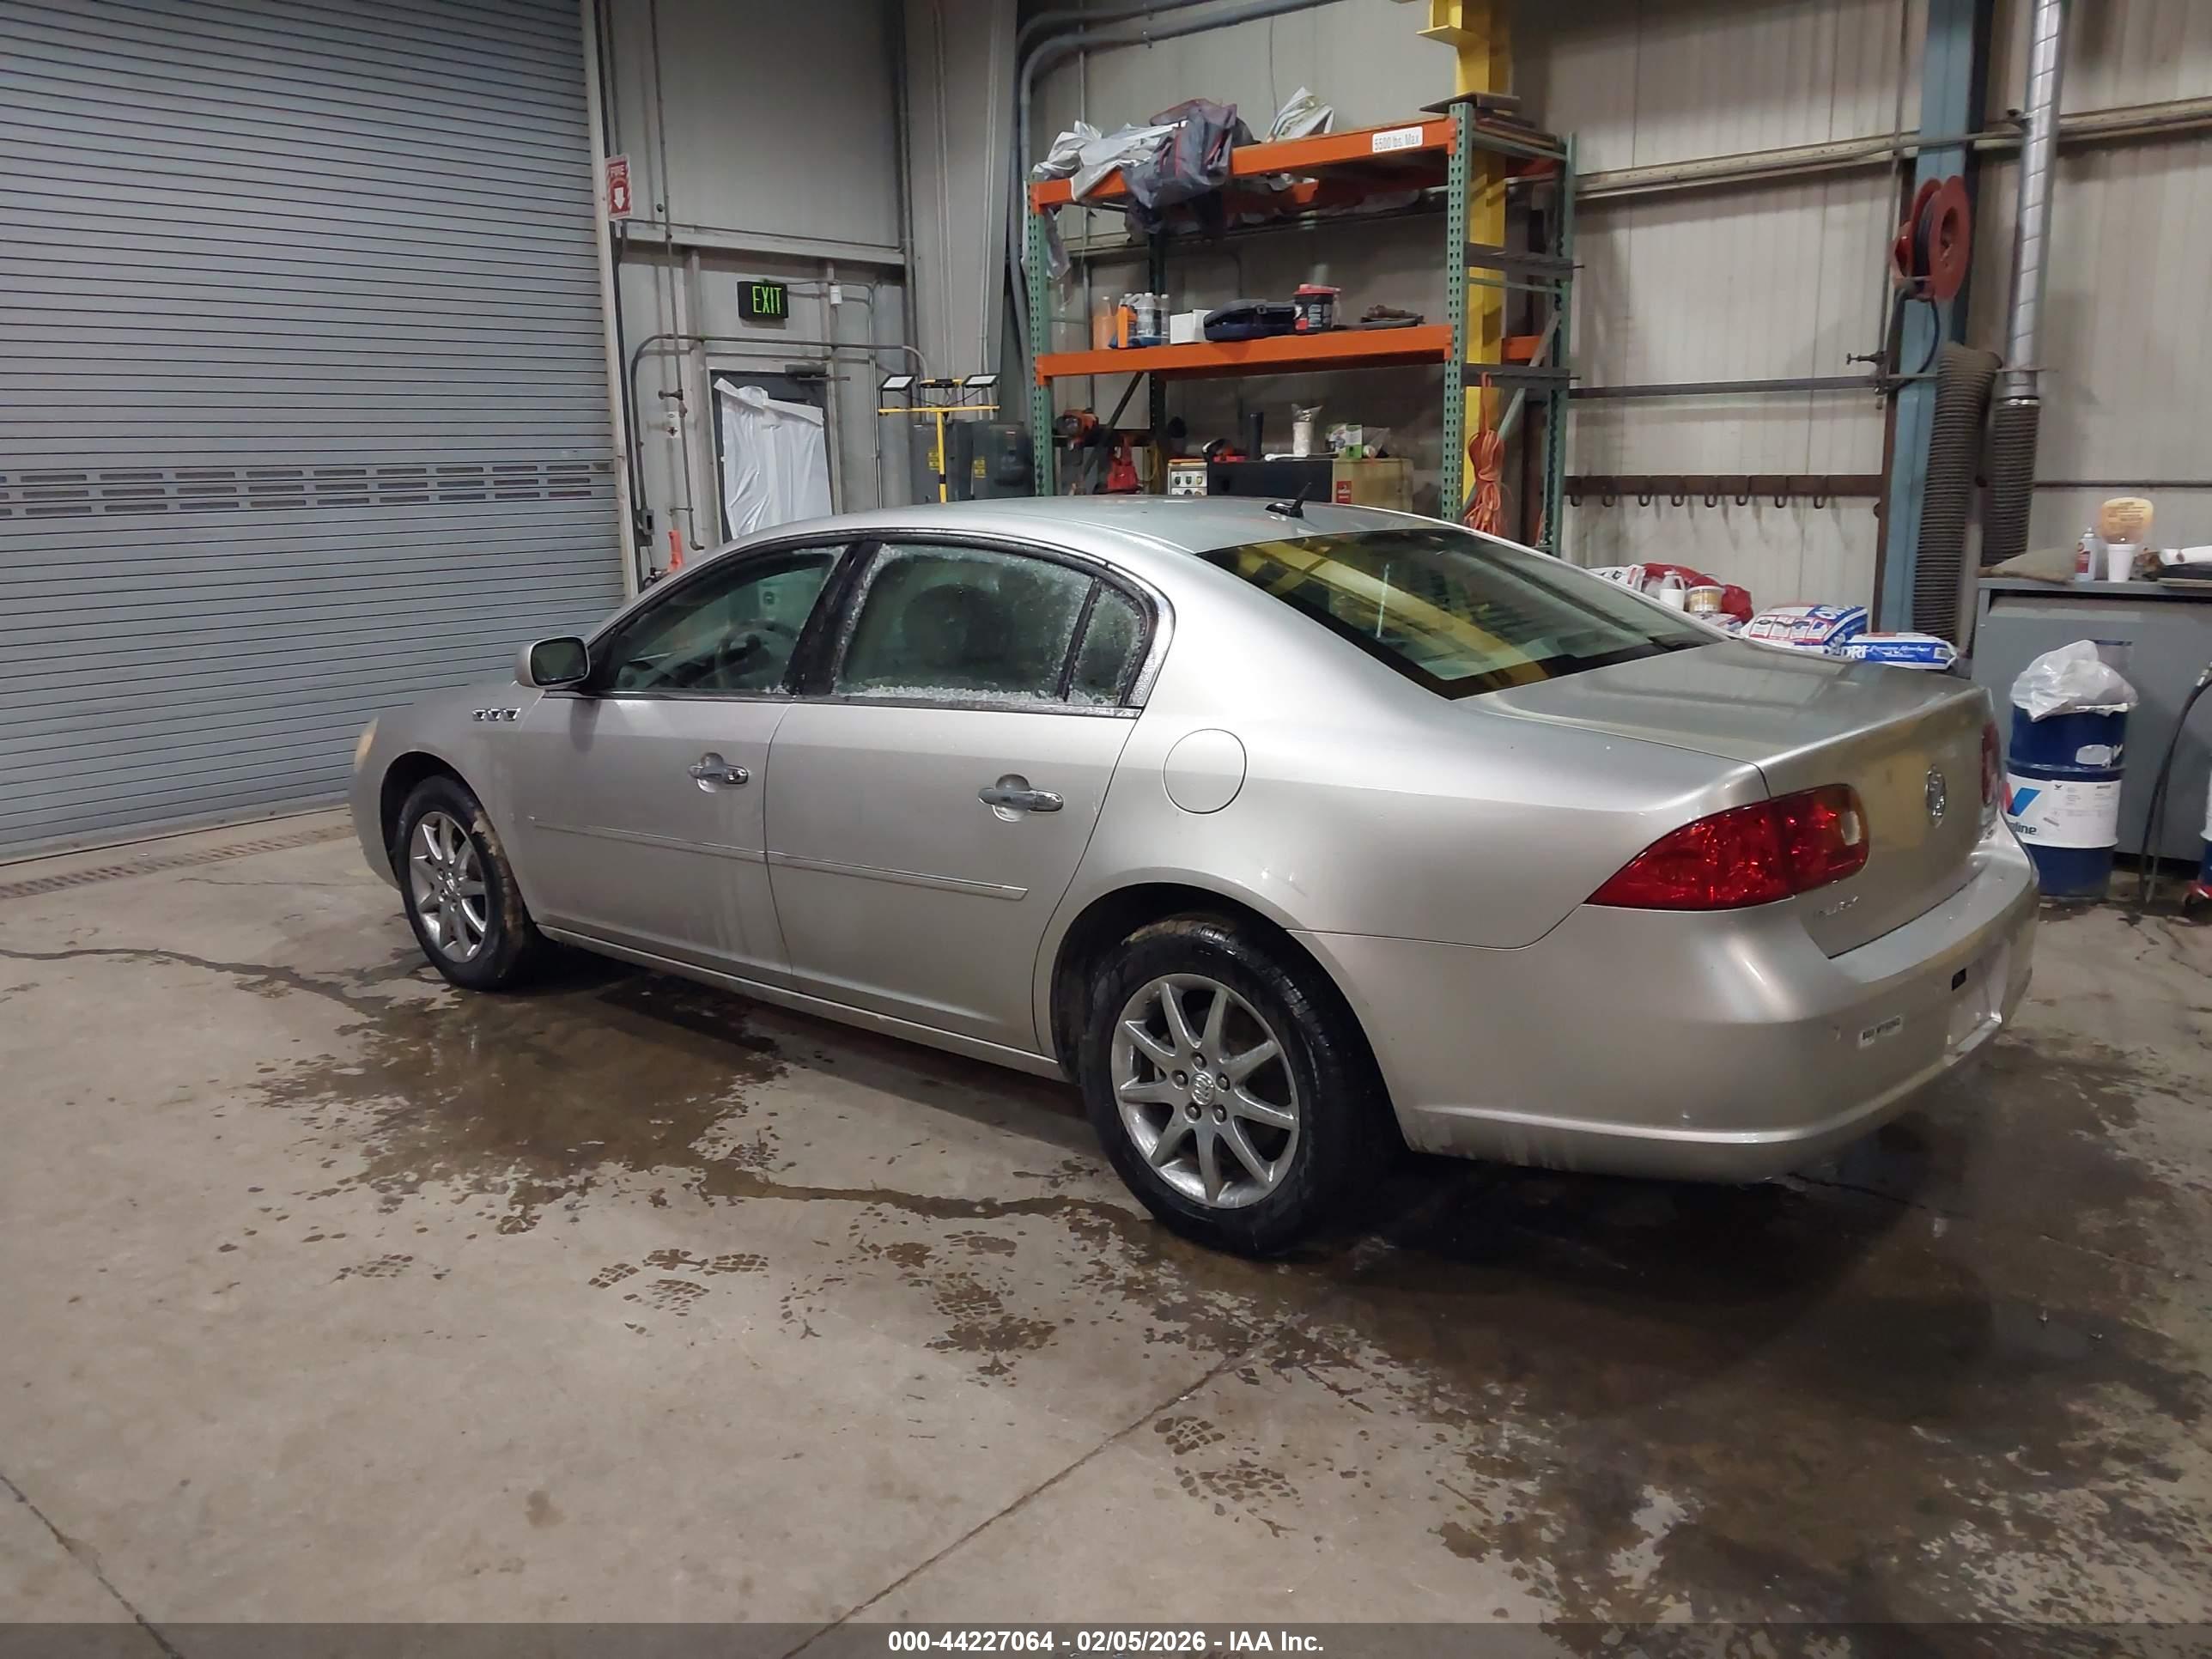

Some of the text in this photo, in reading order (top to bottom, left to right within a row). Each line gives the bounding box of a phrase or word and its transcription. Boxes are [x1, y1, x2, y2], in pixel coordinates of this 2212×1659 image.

[1374, 137, 1392, 151] 5500
[611, 164, 626, 178] FIRE
[752, 286, 782, 314] EXIT
